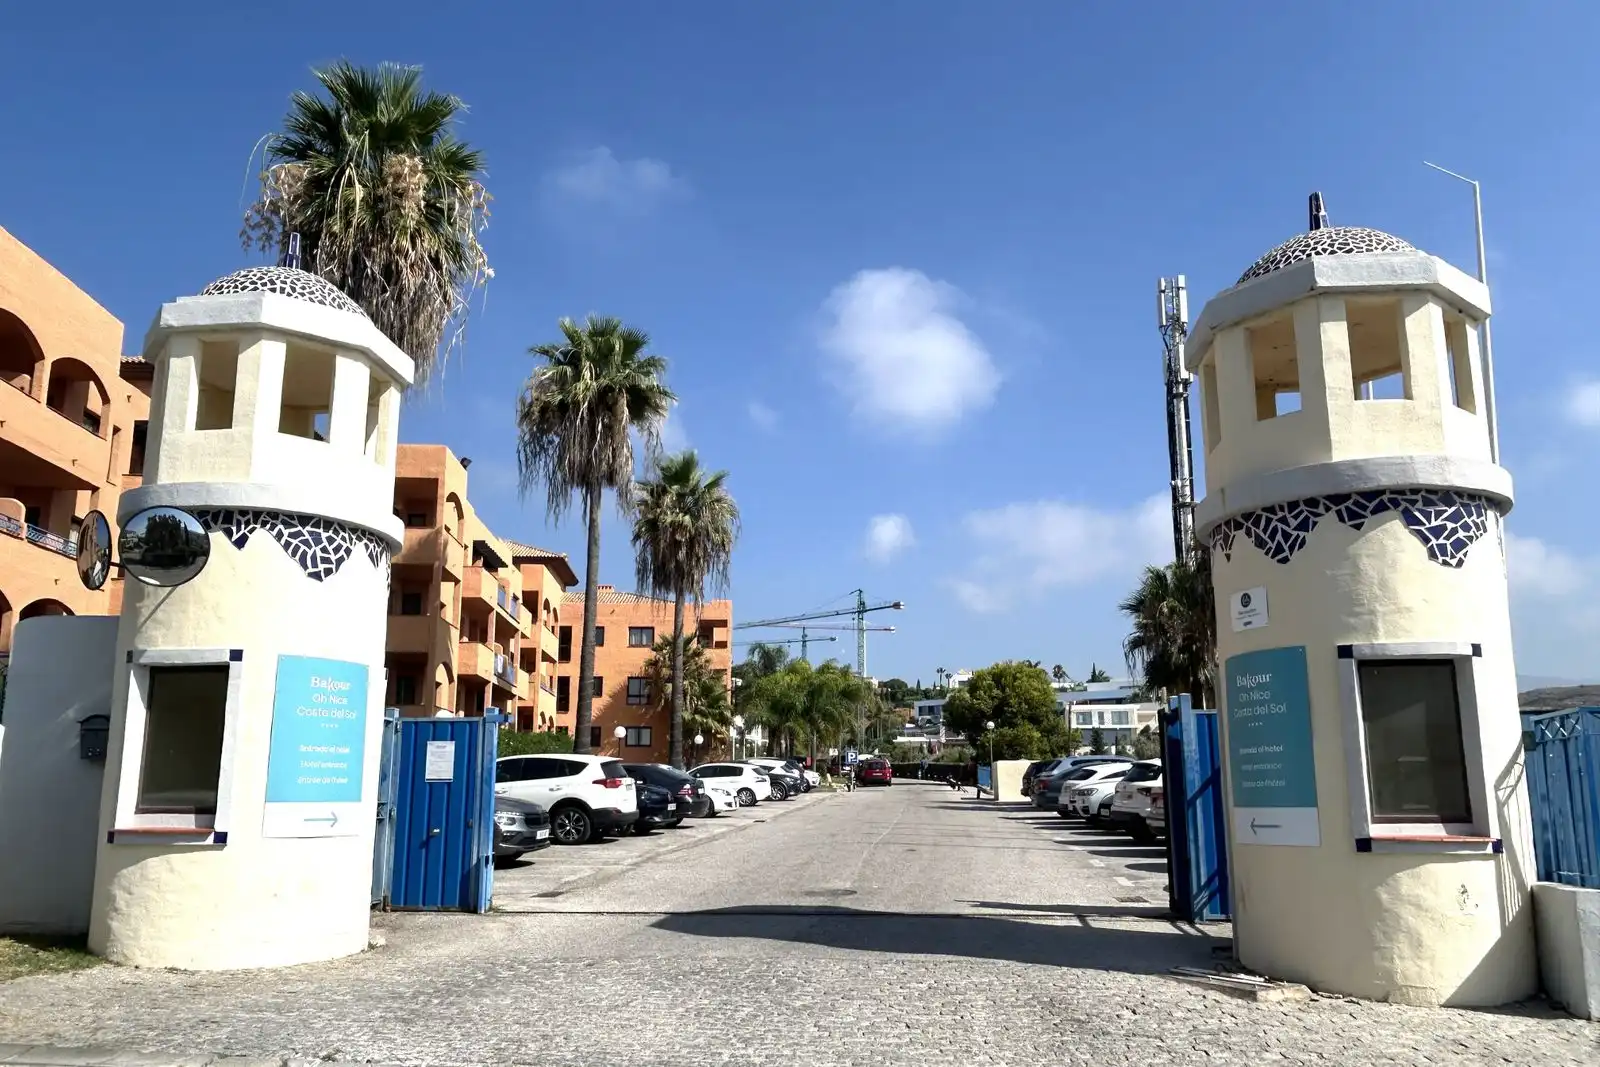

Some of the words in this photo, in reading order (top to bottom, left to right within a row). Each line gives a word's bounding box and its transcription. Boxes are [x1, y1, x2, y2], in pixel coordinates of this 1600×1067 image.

[311, 676, 351, 692] Bakour
[1236, 673, 1272, 688] Bakour
[312, 693, 327, 704] Oh
[329, 694, 349, 705] Nice
[1250, 691, 1271, 700] Nice
[1253, 705, 1268, 715] del
[1270, 702, 1287, 714] Sol
